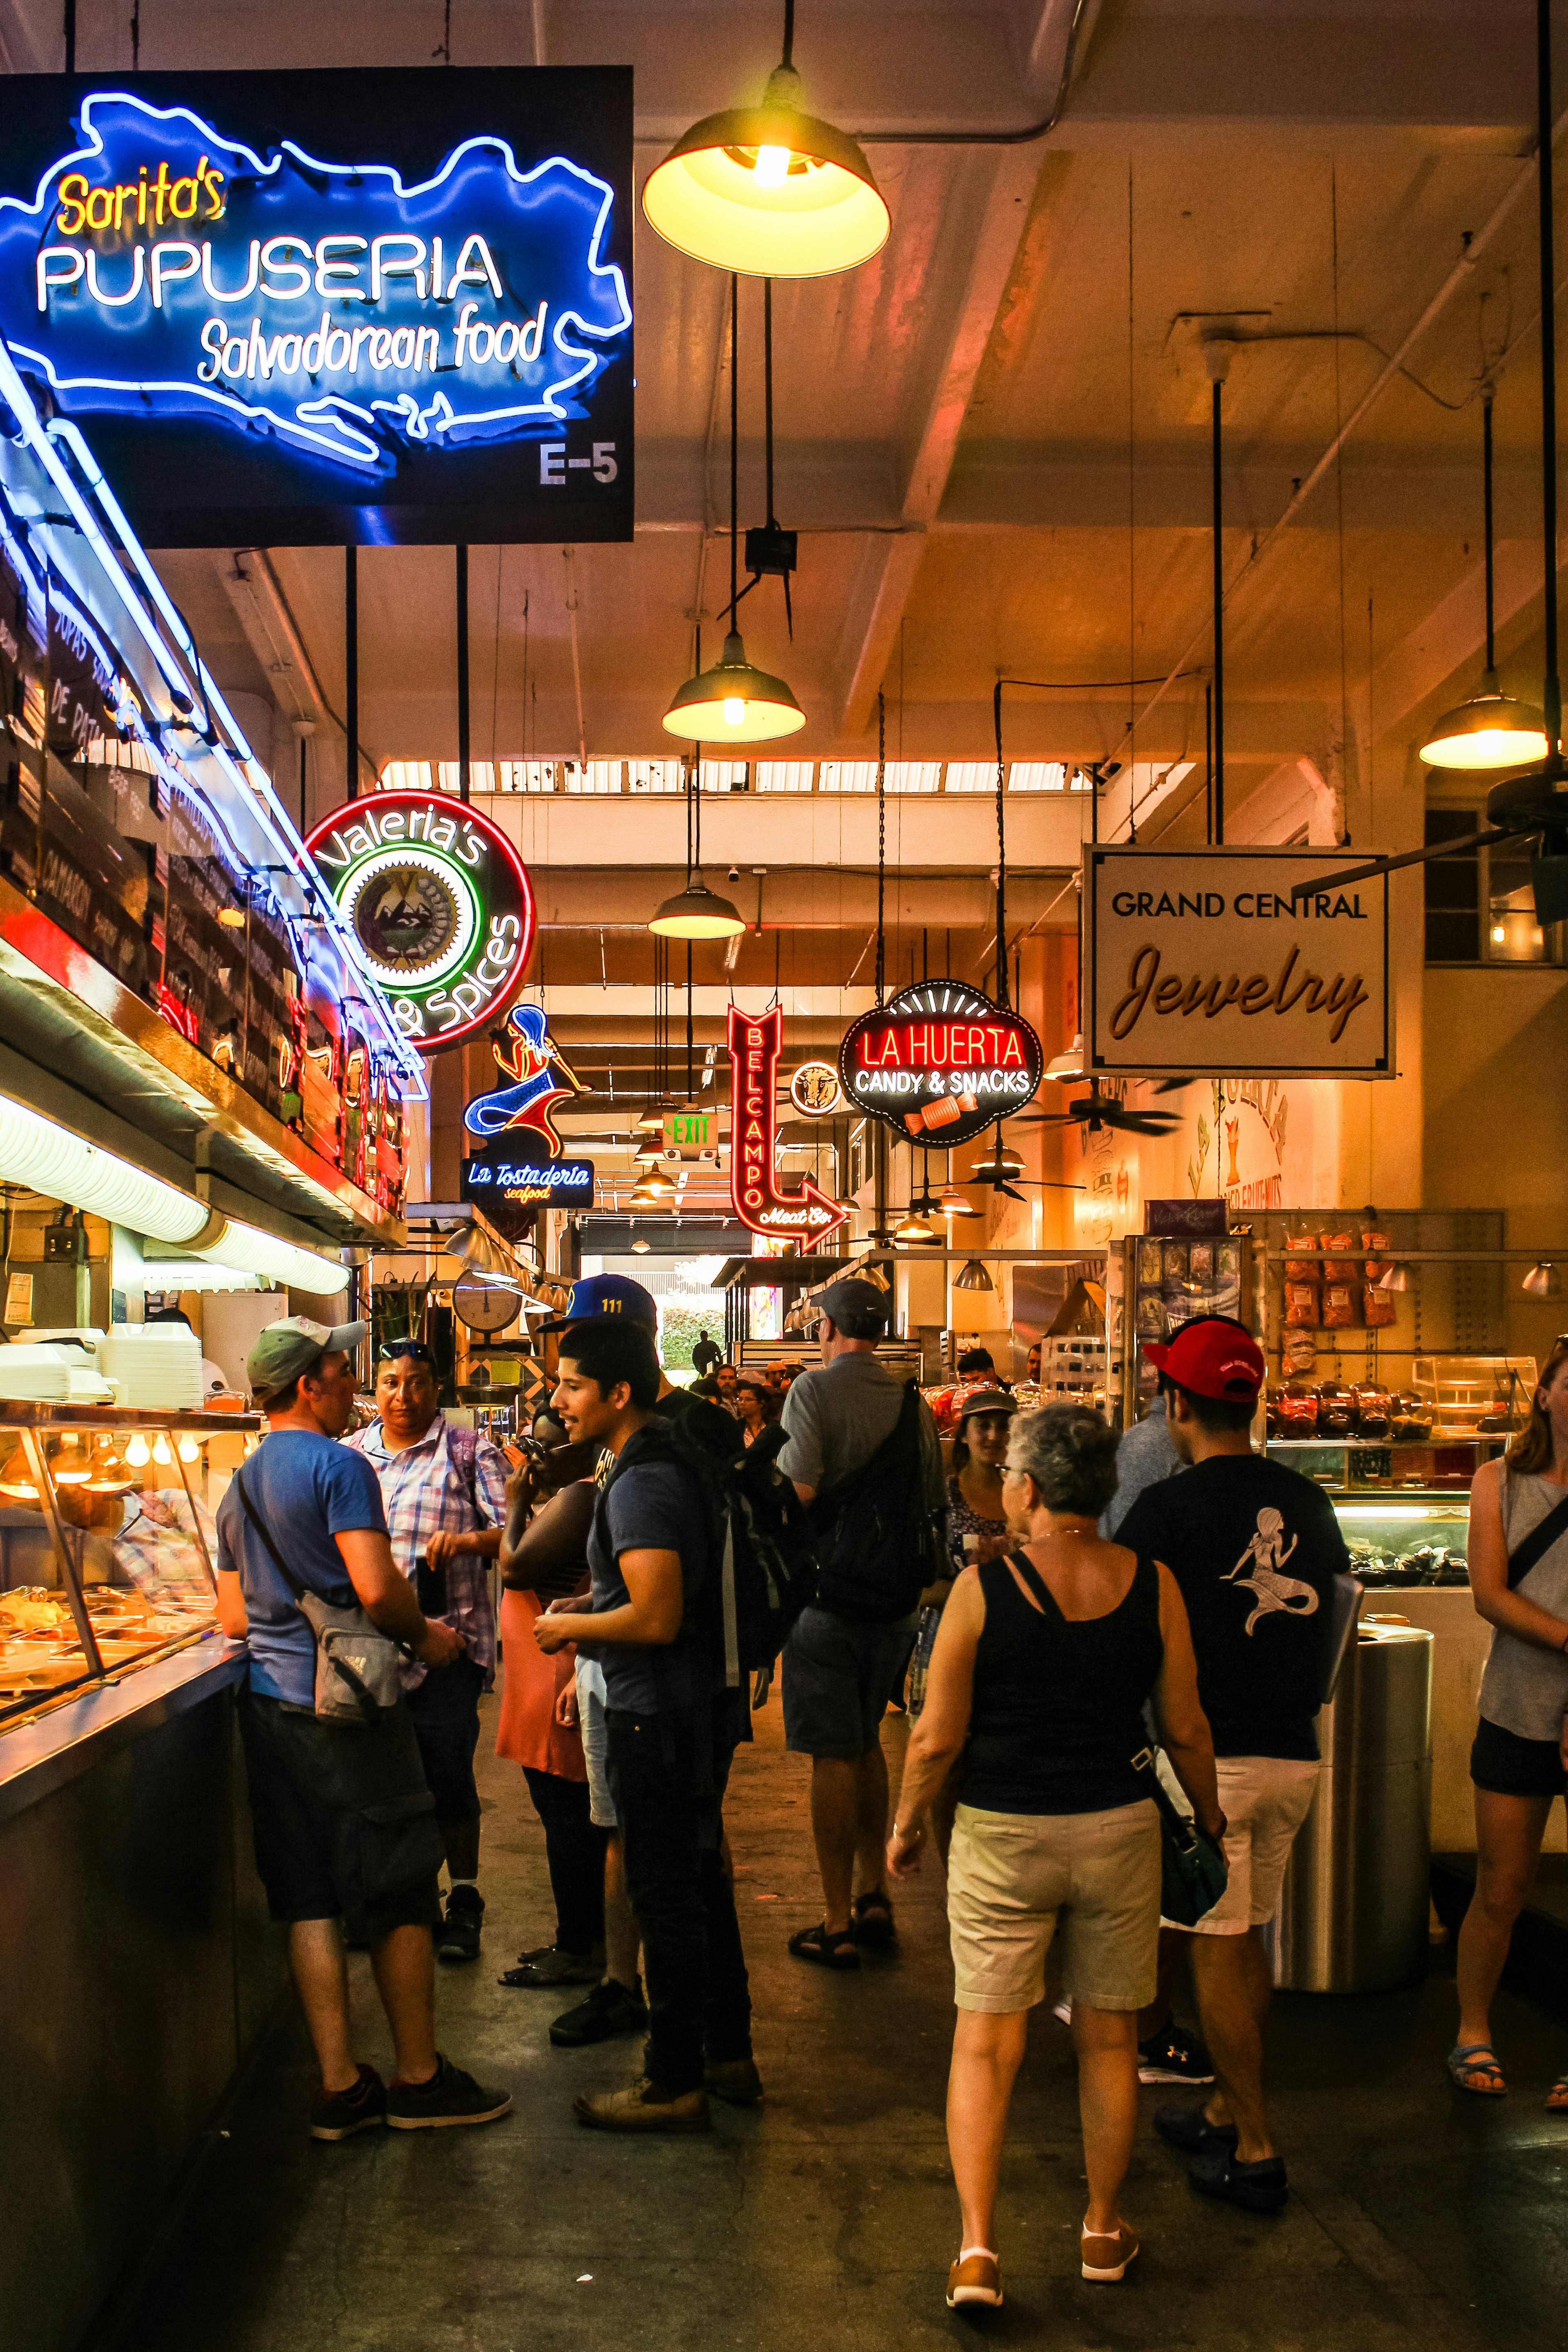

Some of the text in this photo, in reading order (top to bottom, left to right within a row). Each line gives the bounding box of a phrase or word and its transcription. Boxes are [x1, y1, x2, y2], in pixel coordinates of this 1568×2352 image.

[56, 155, 225, 235] Sarita's
[37, 234, 503, 311] PUPUSERIA
[197, 300, 548, 383] Salvadorean food
[539, 442, 618, 485] E-5
[314, 803, 488, 865] Valeria's
[1112, 892, 1368, 919] GRAND CENTRAL
[425, 914, 520, 1032] Spices
[1108, 942, 1369, 1044] Jewelry
[864, 1025, 1022, 1065] LA HUERTA
[856, 1069, 1030, 1094] CANDY & SNACKS
[674, 1116, 709, 1144] EXIT
[744, 1027, 764, 1209] BELCAMPO
[468, 1163, 491, 1183] La
[504, 1185, 551, 1204] seafood
[759, 1207, 809, 1224] Meat
[602, 1298, 621, 1313] 111
